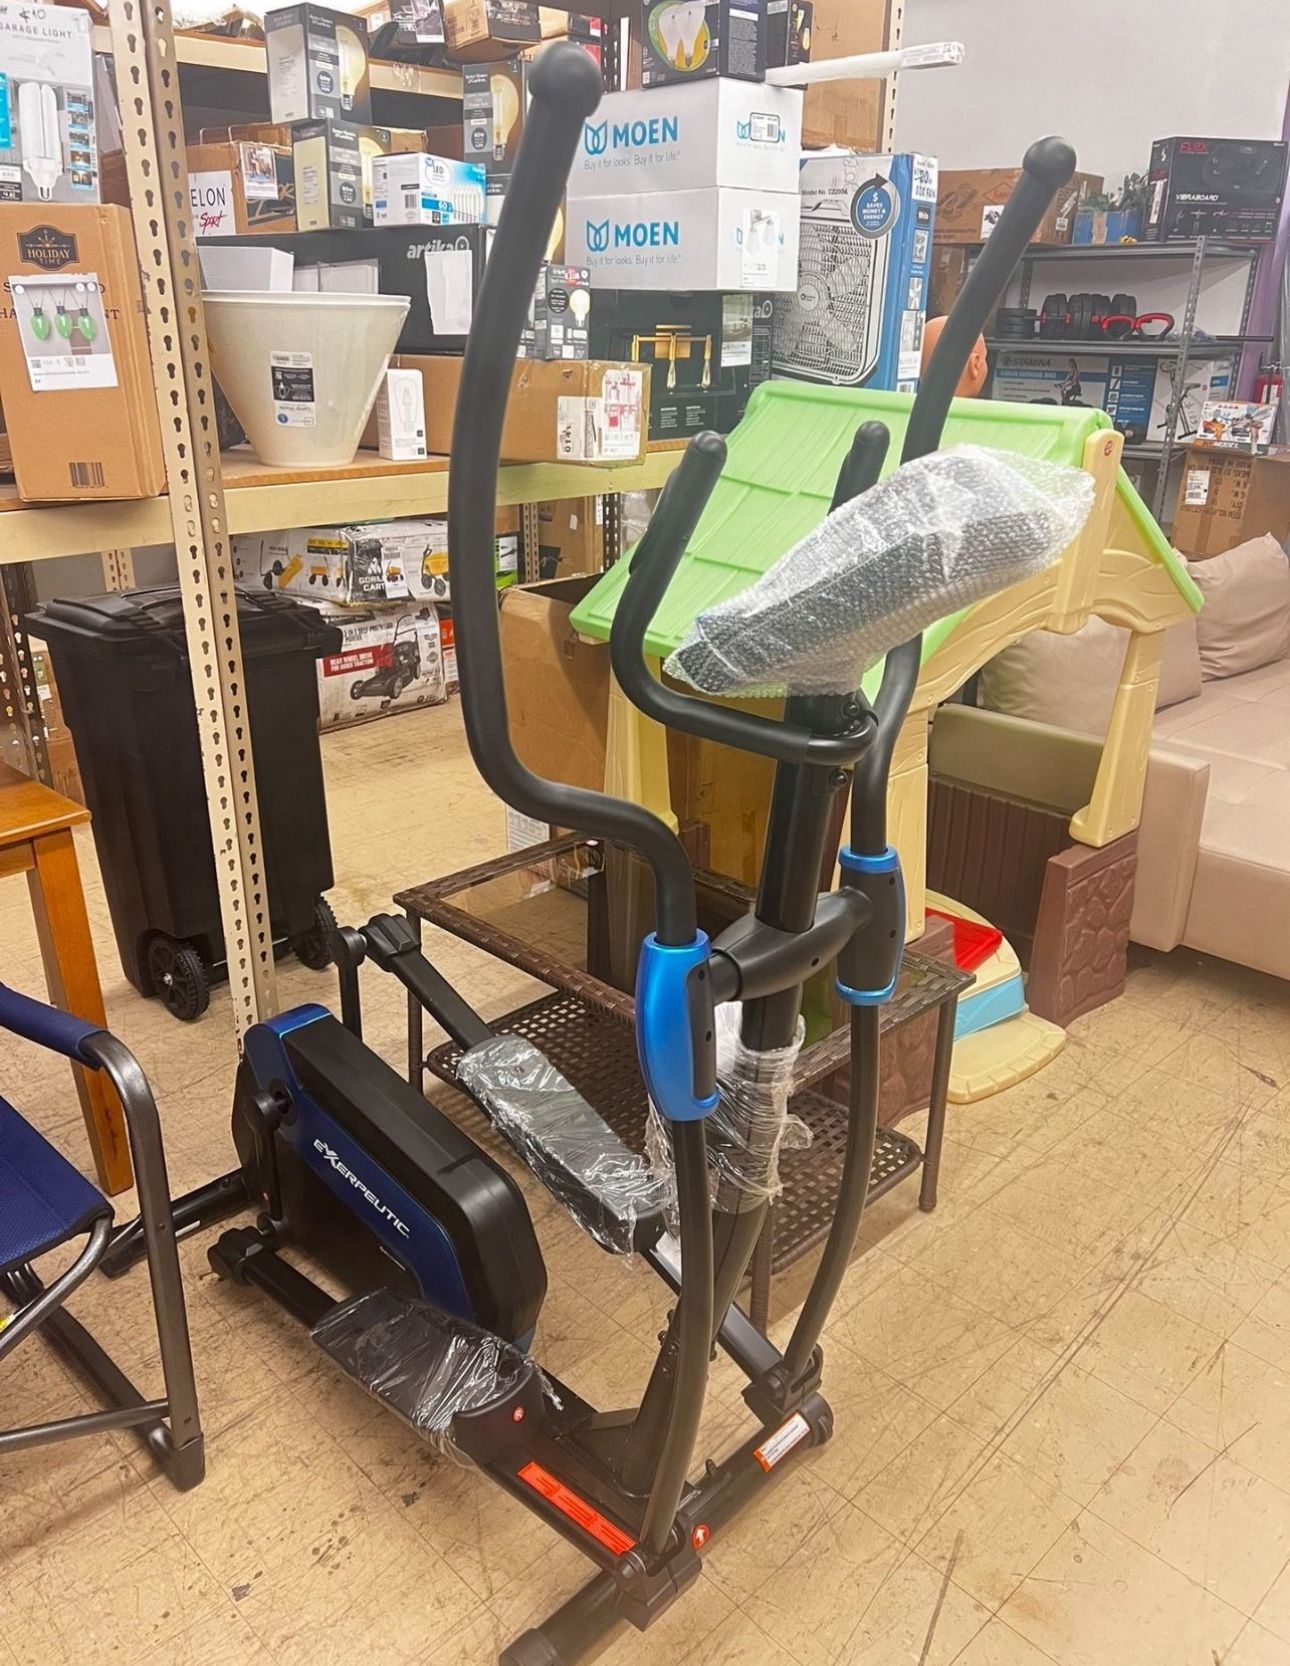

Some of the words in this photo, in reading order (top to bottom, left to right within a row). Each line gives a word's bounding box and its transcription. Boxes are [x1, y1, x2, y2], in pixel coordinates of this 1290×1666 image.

[0, 22, 39, 35] GARAGE
[42, 28, 72, 39] LIGHT
[613, 116, 678, 148] MOEN
[584, 158, 597, 171] Buy
[604, 157, 612, 168] for
[634, 156, 648, 168] Buy
[655, 153, 664, 163] for
[190, 188, 226, 207] ELON
[614, 221, 679, 248] MOEN
[27, 248, 70, 259] HOLIDAY
[586, 256, 599, 267] Buy
[605, 255, 614, 265] for
[635, 254, 649, 267] Buy
[655, 254, 666, 265] for
[1013, 356, 1051, 368] STAMINA
[363, 583, 385, 592] CART
[313, 1139, 410, 1239] EXERPEUTIC
